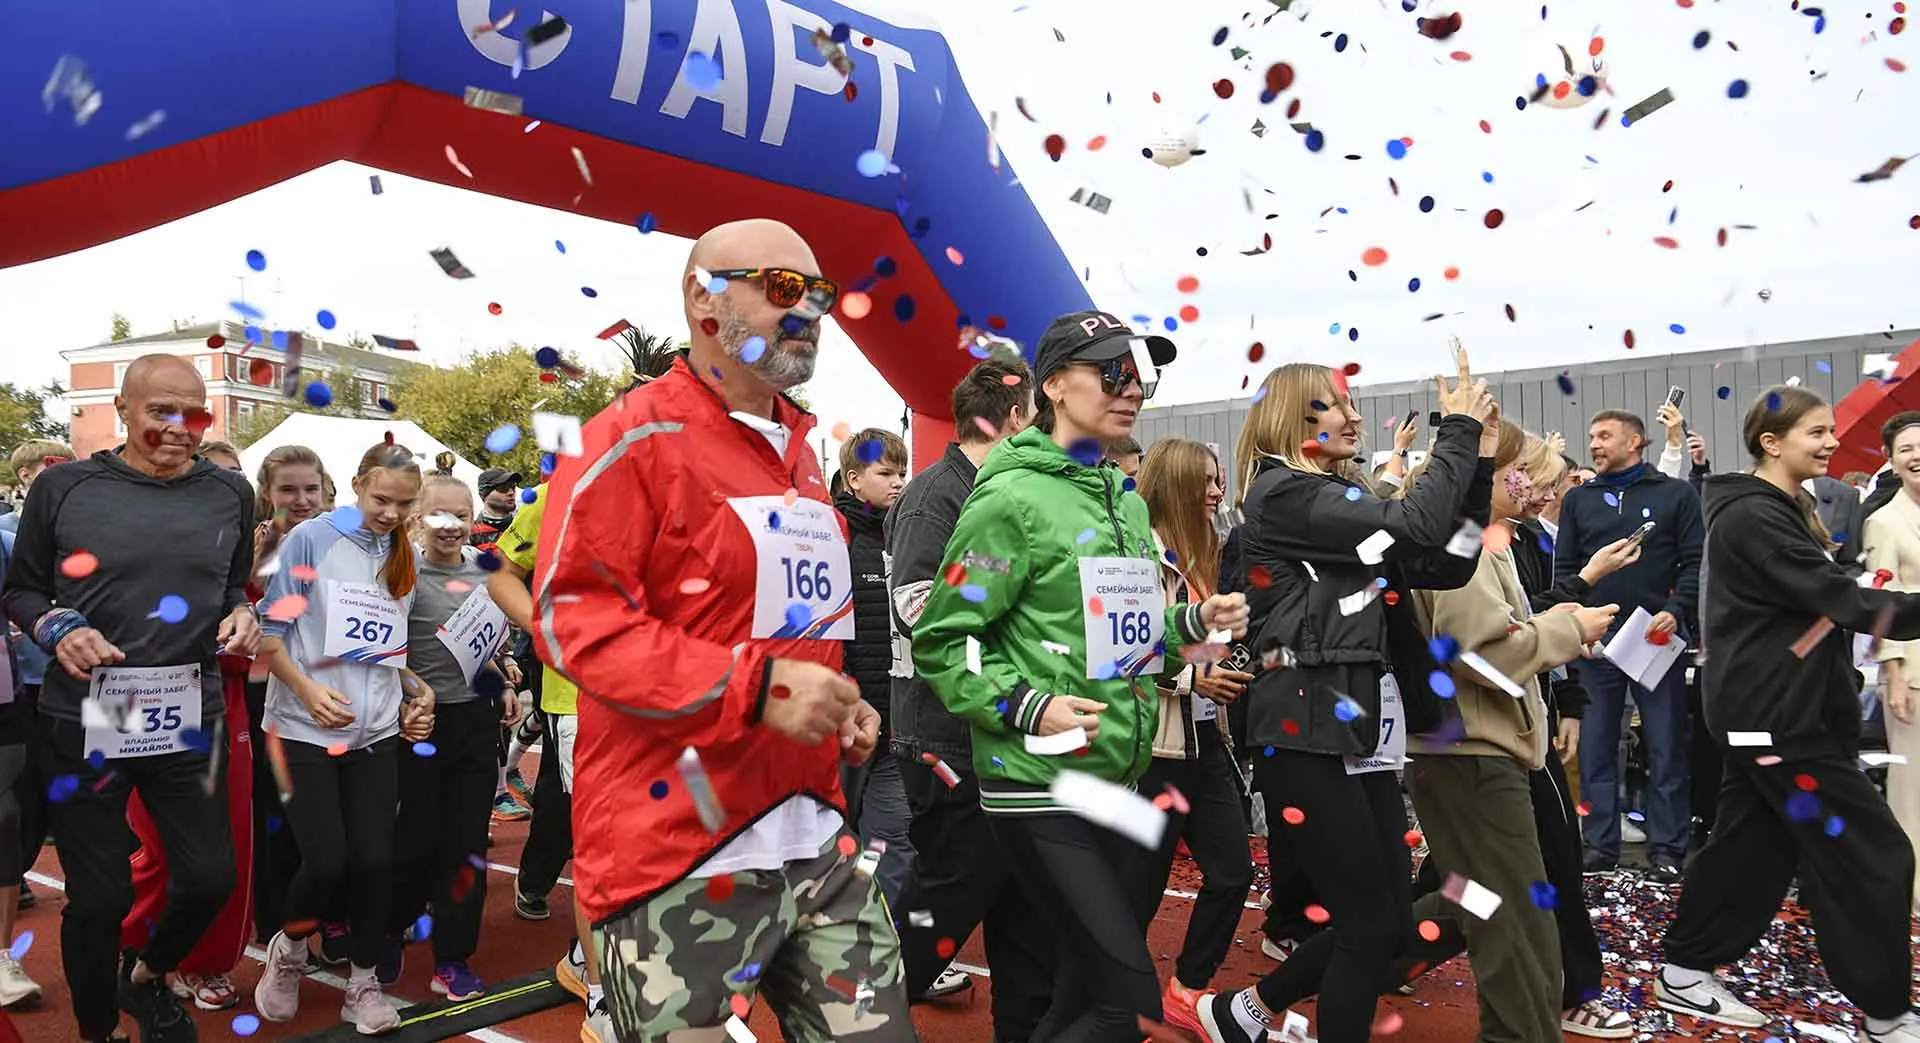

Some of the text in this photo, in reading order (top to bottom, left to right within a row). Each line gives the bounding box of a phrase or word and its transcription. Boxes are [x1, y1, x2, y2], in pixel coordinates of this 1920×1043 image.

[1080, 315, 1127, 337] PL
[763, 524, 810, 538] СЕЙНЫЙ
[781, 557, 832, 601] 166
[1096, 584, 1138, 594] СЕМЕЙНЫЙ
[340, 598, 379, 610] СЕМЕЙНЫЙ
[345, 616, 393, 645] 267
[1107, 611, 1151, 645] 168
[468, 622, 497, 659] 312
[105, 684, 189, 696] СЕМЕЙНЫЙ ЗАБЕГ
[115, 705, 182, 734] 35
[124, 735, 170, 746] ВЛАДИМИР
[1382, 718, 1395, 745] 7
[119, 743, 174, 755] МИХАЙЛОВ
